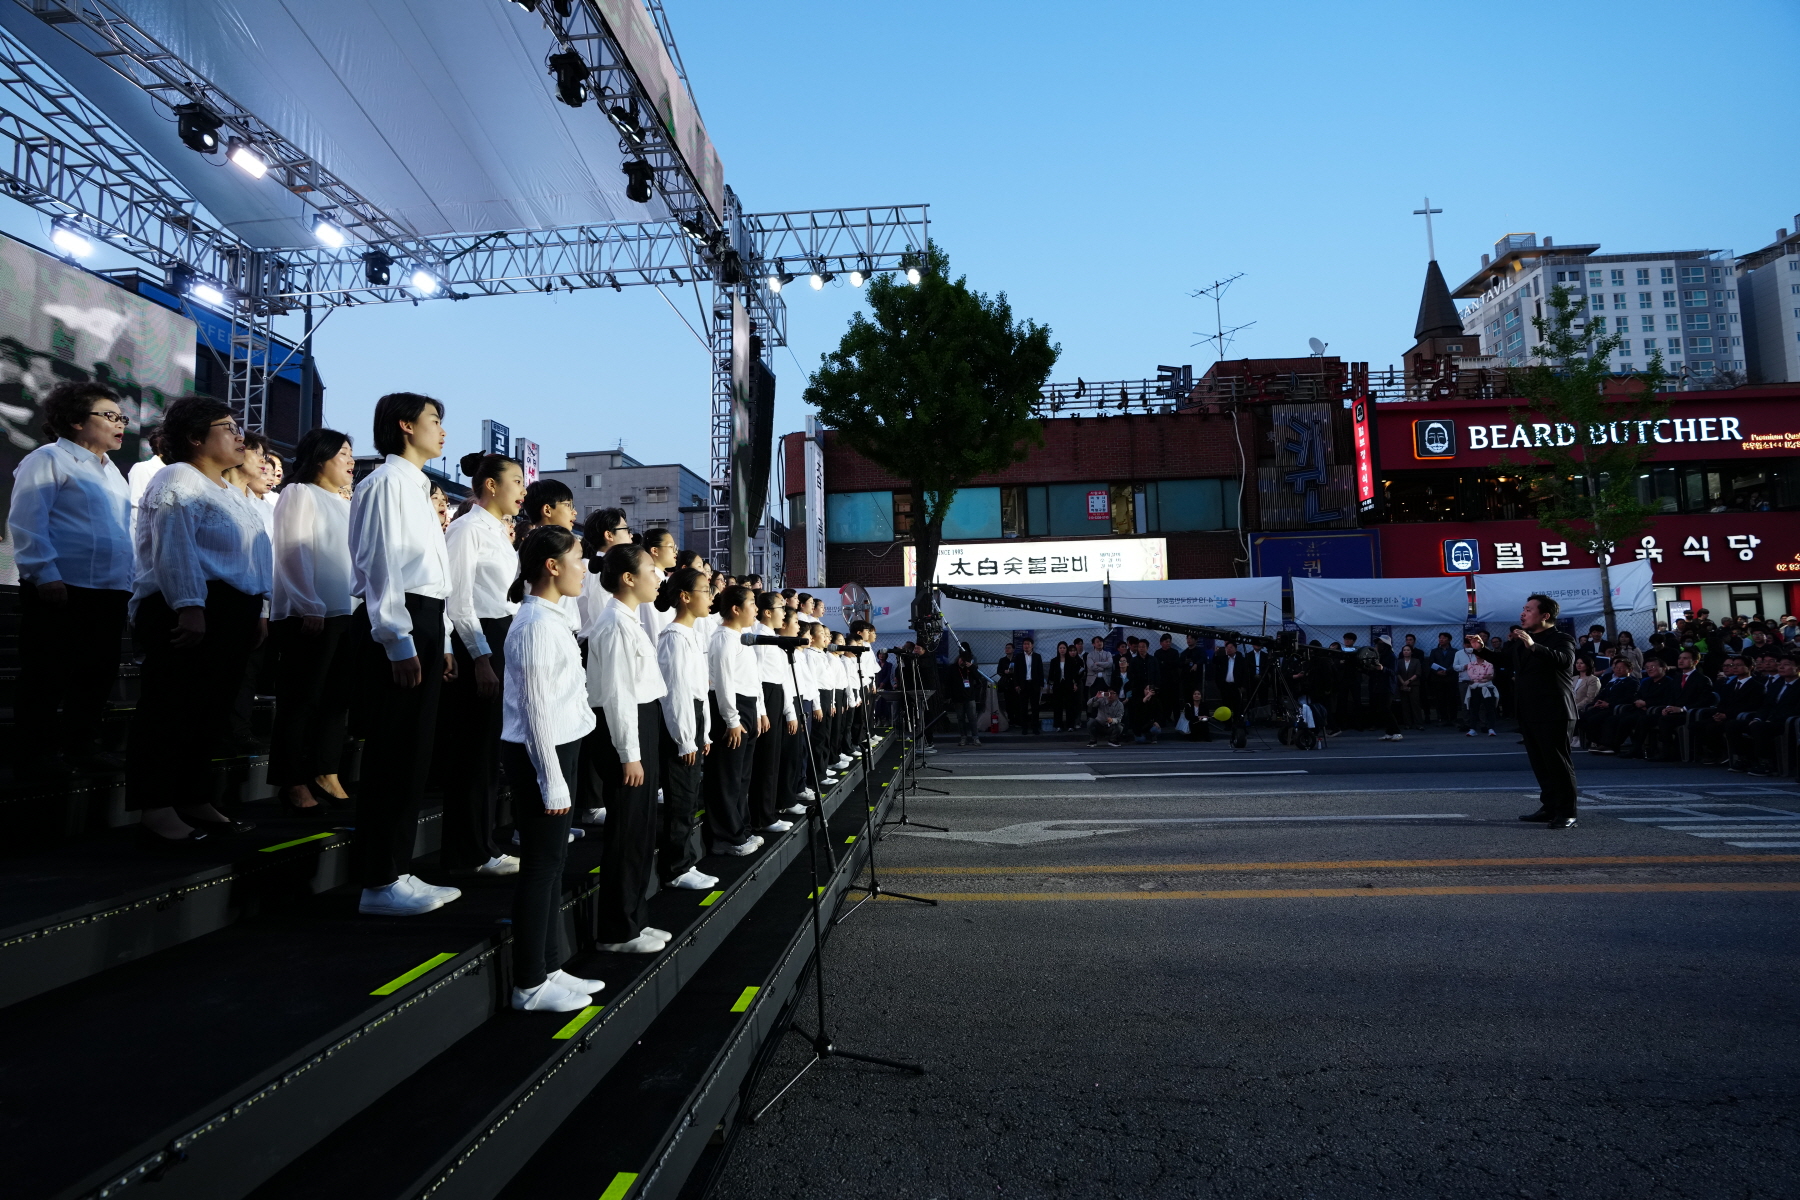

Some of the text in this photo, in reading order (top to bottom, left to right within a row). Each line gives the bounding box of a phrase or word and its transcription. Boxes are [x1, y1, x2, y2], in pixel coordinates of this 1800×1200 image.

[1468, 416, 1743, 449] BEARD BUTCHER
[1751, 433, 1784, 441] Premium
[1776, 563, 1788, 572] 02
